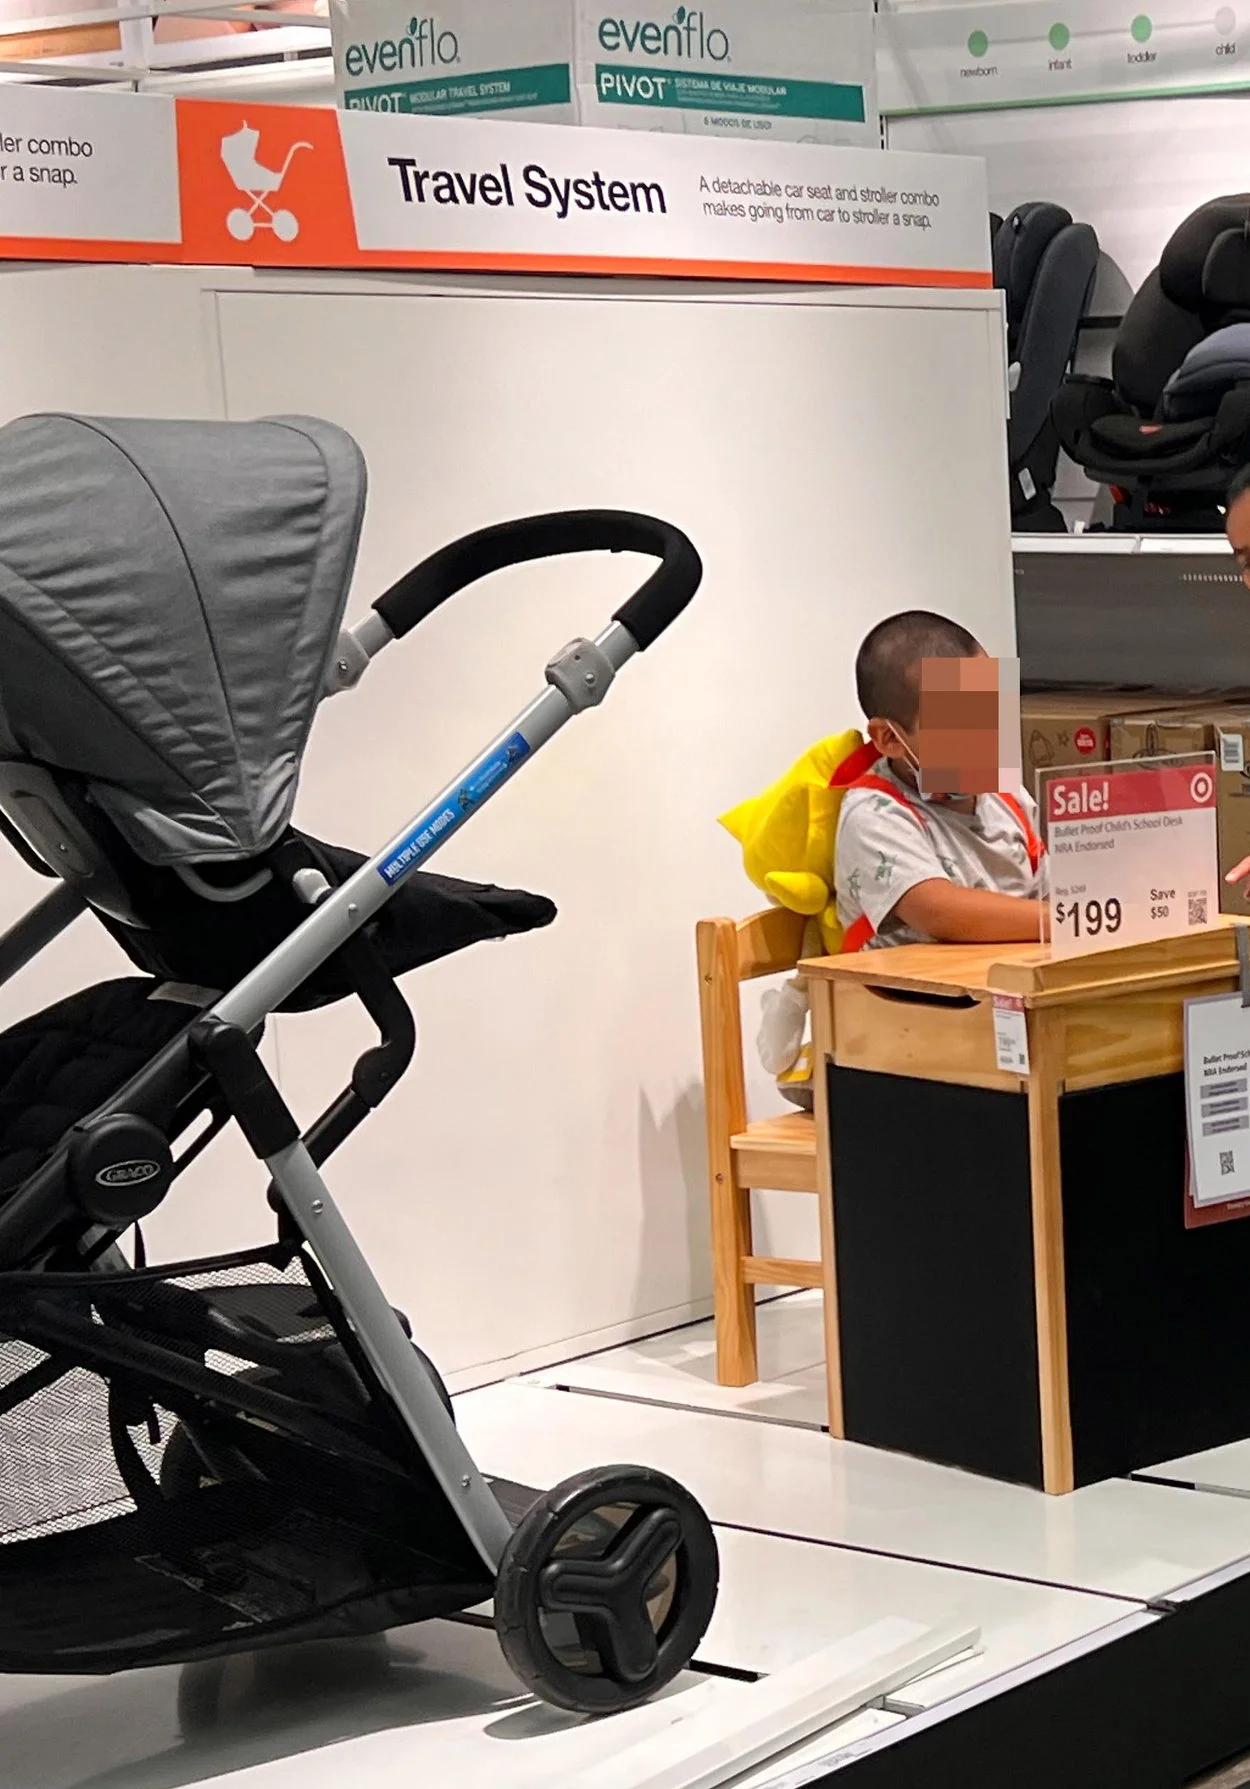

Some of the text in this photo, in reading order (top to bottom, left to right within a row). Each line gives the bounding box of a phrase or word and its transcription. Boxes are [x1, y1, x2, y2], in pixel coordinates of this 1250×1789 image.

[598, 6, 732, 61] evenflo
[345, 17, 461, 77] evenflo
[960, 66, 998, 78] newborn
[1048, 58, 1072, 71] infant
[449, 84, 478, 98] TRAVEL
[480, 80, 511, 96] SYSTEM
[600, 71, 666, 99] PIVOT
[27, 136, 93, 158] combo
[13, 165, 25, 182] a
[29, 166, 78, 189] snap.
[387, 157, 667, 219] Travel System
[700, 176, 940, 207] A detachable car seat and stroller combo
[703, 201, 931, 231] makes going from car to stroller a snap.
[1053, 781, 1109, 816] Sale!
[1134, 818, 1162, 830] School
[1163, 816, 1183, 827] Desk
[1150, 888, 1175, 901] Save
[1056, 898, 1121, 937] $199
[1151, 906, 1169, 919] $50
